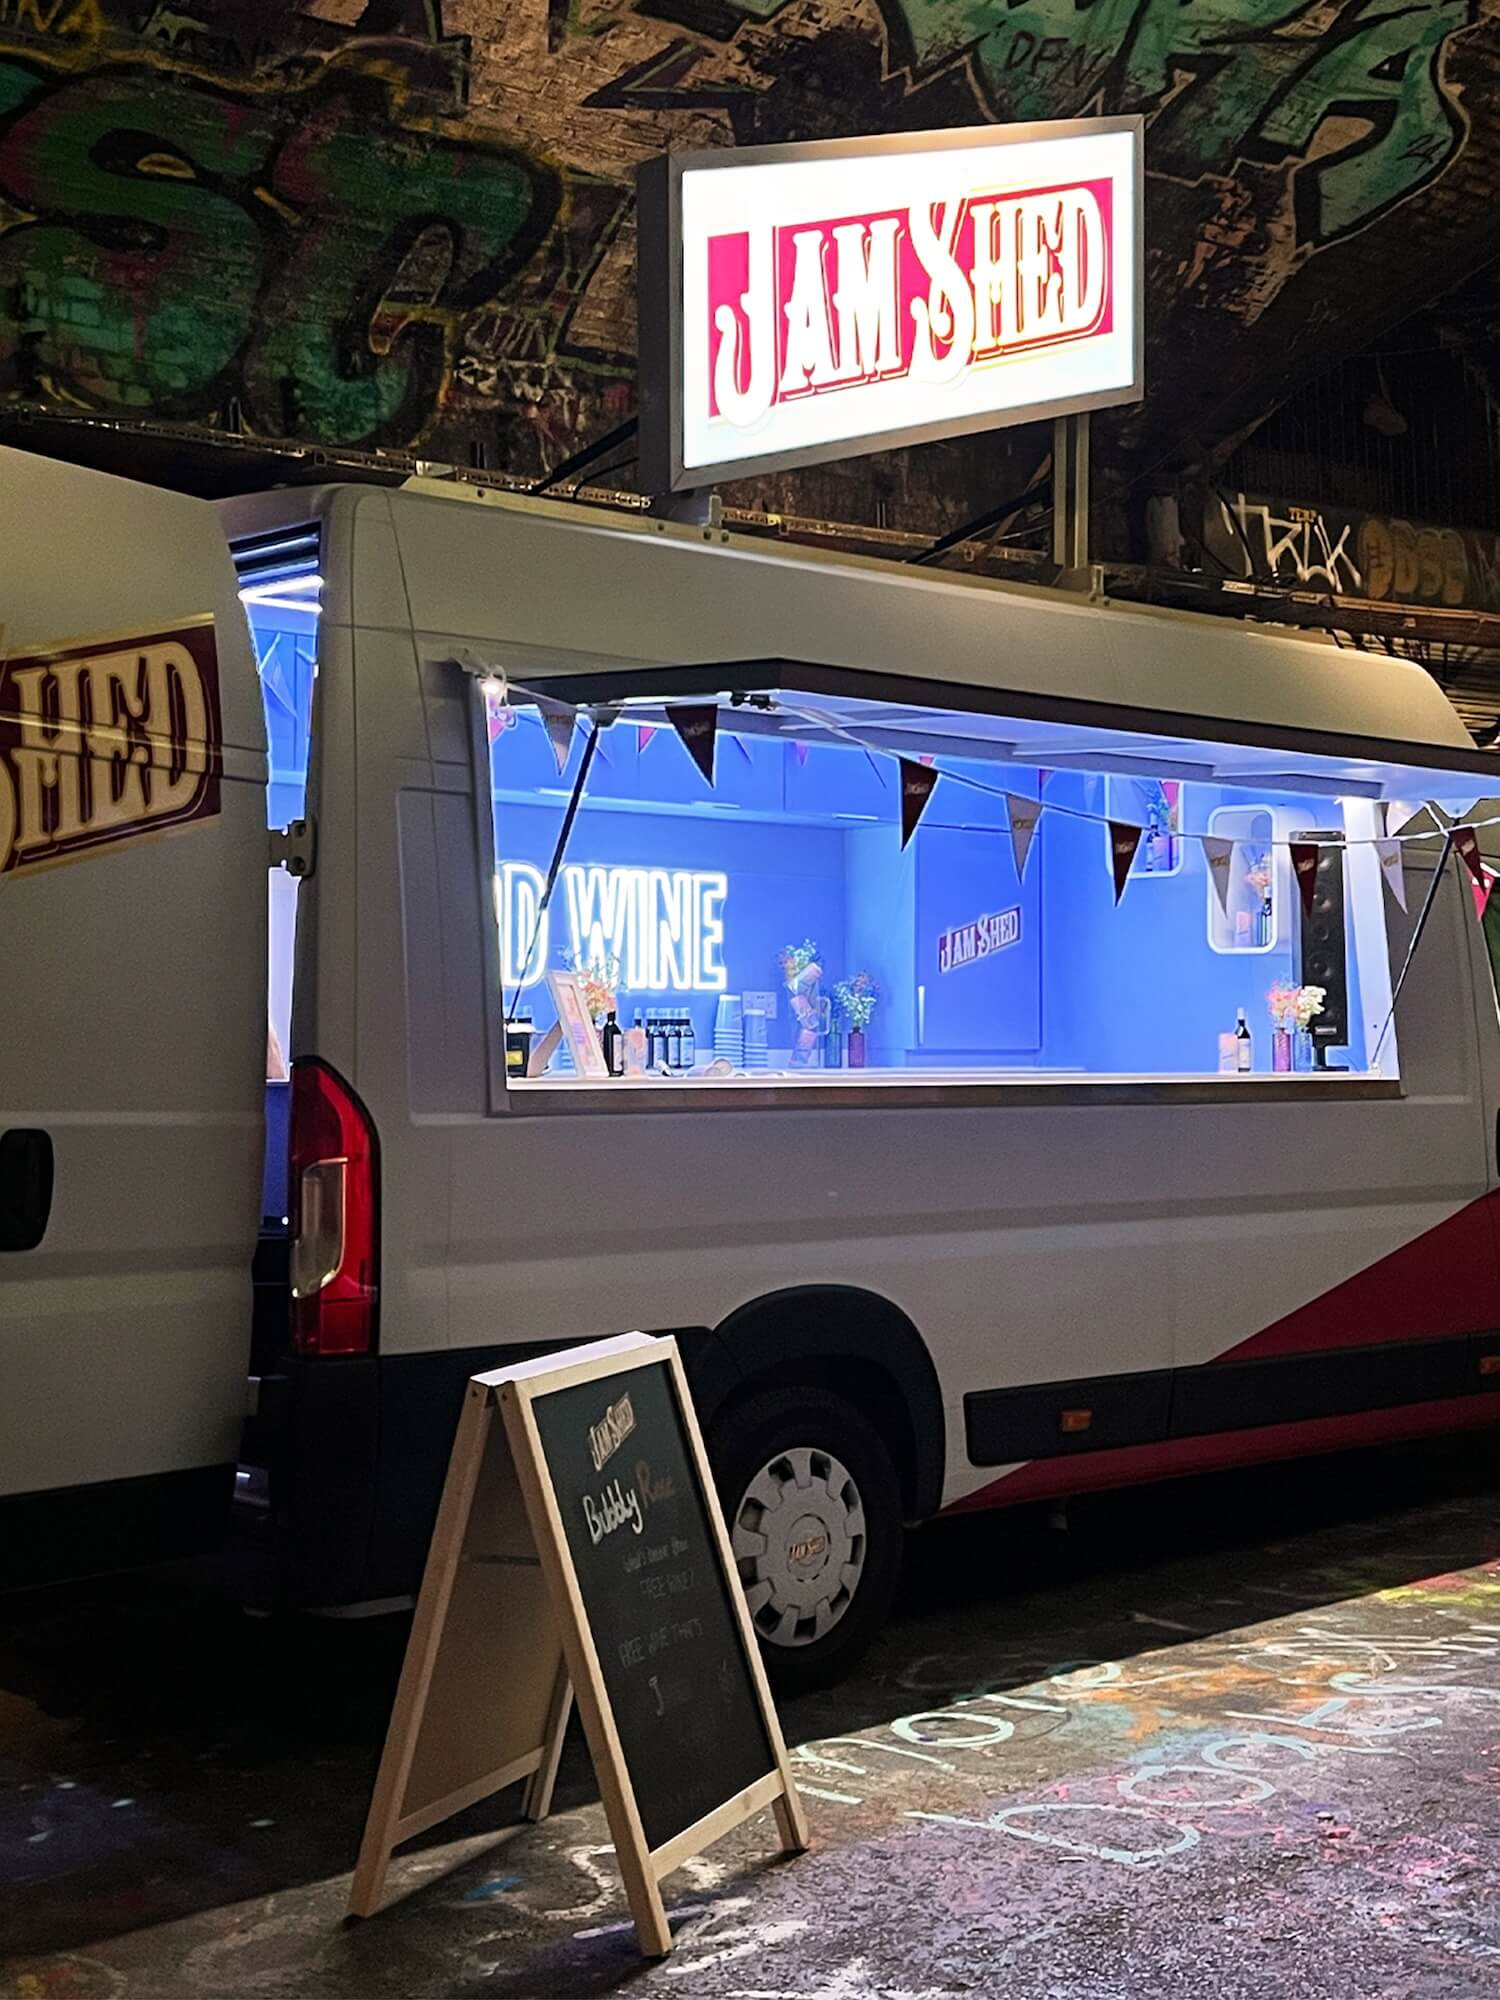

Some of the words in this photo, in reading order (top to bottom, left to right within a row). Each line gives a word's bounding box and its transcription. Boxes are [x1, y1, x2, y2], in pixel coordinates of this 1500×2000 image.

[494, 862, 549, 989] D
[562, 864, 728, 990] WINE
[582, 1477, 644, 1545] Bubbly
